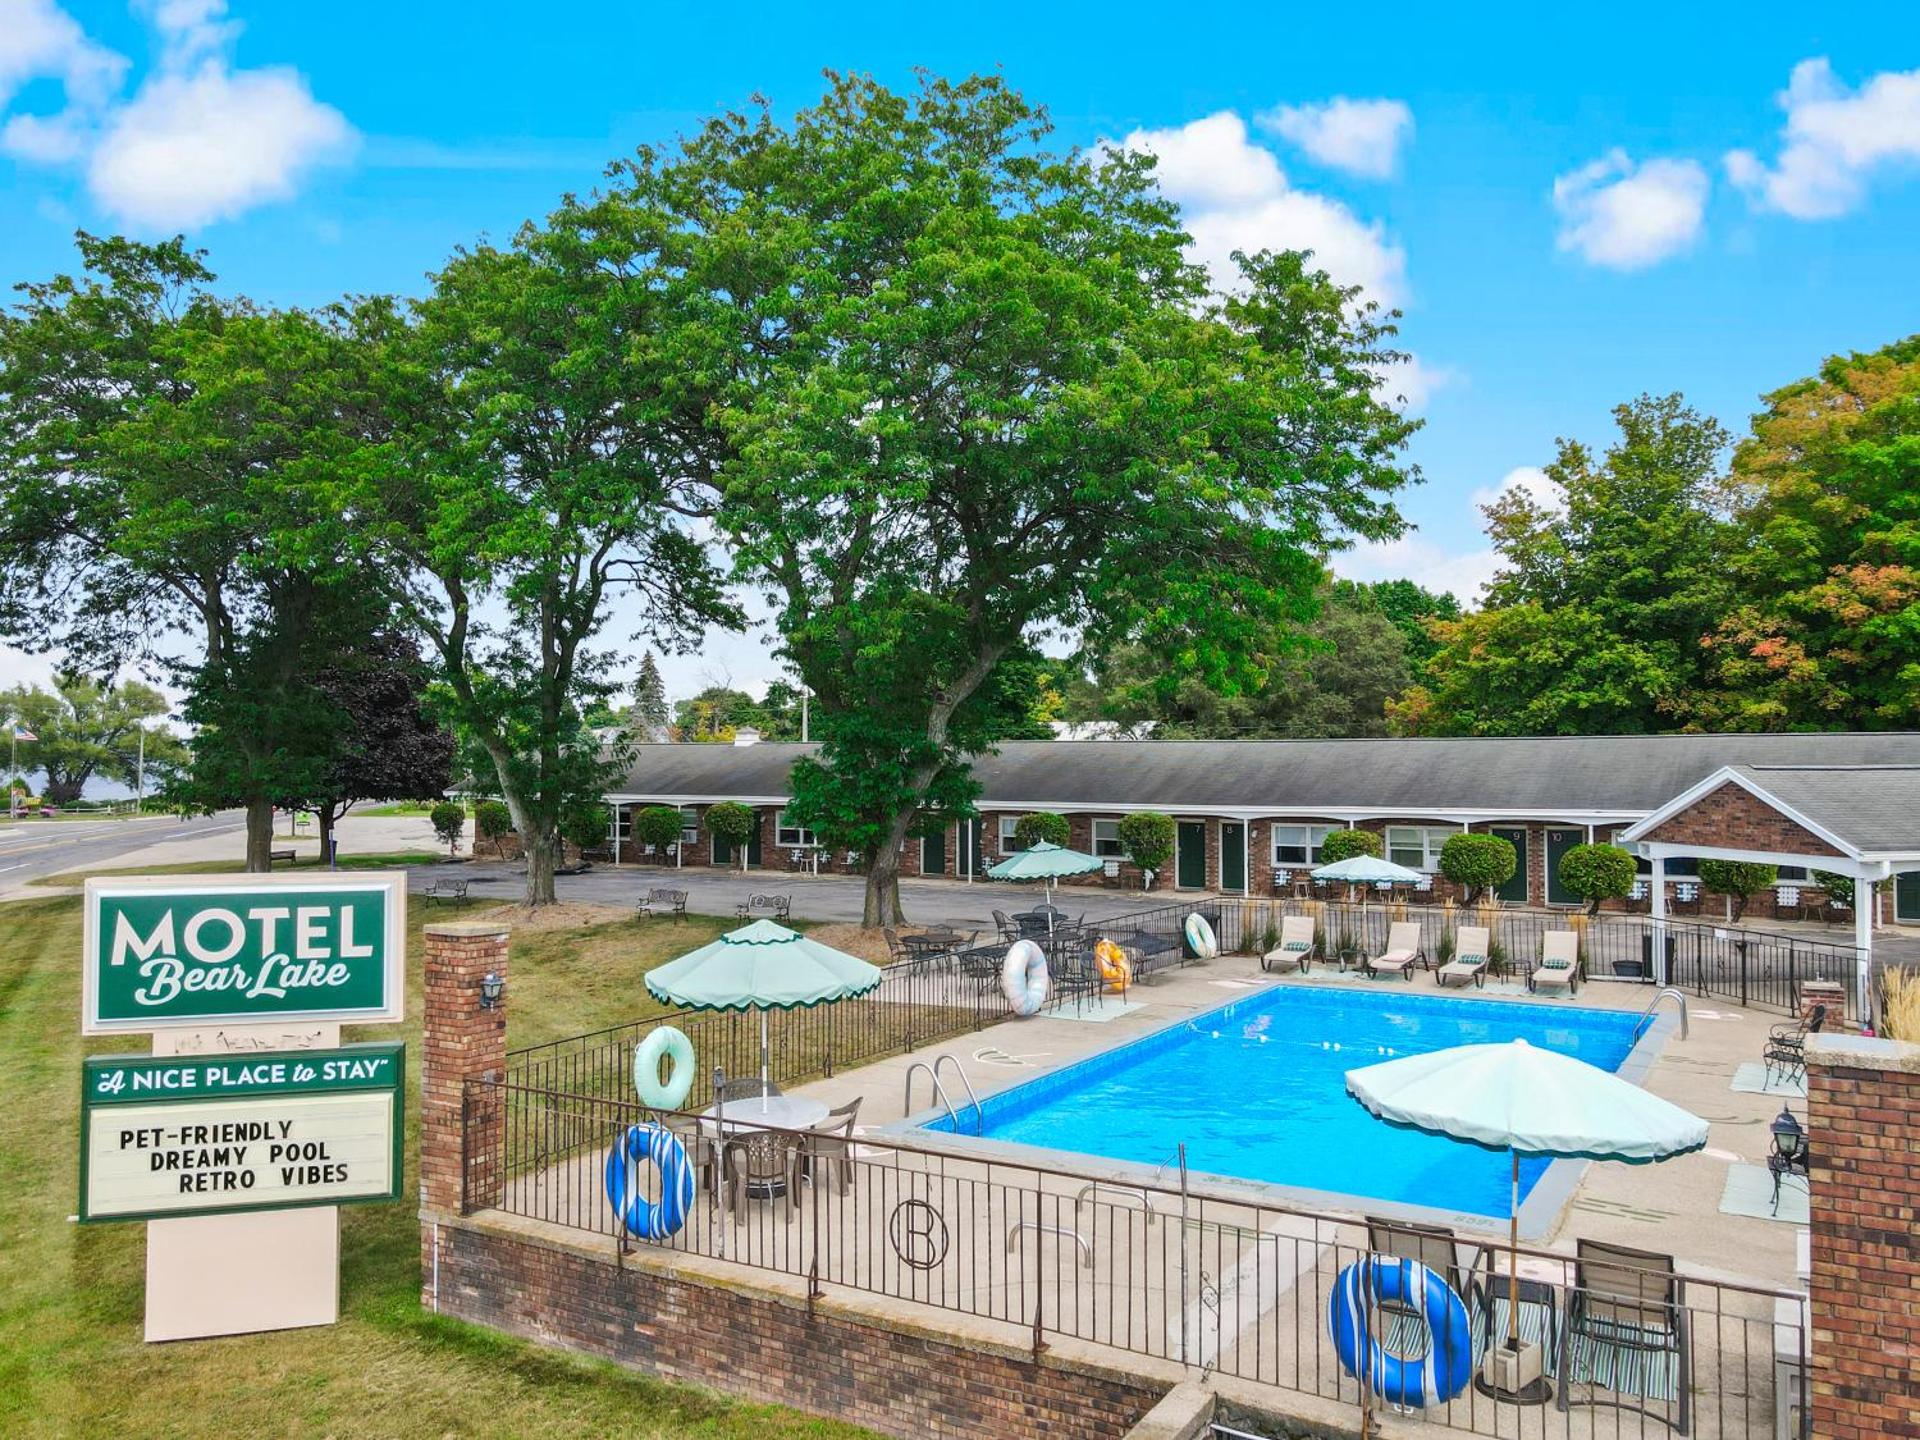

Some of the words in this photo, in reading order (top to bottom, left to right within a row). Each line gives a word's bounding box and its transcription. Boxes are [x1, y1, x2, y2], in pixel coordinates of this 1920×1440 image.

[1513, 832, 1520, 840] 9
[1552, 833, 1562, 841] 10
[111, 905, 374, 966] MOTEL
[134, 958, 253, 1006] Bear
[246, 954, 351, 999] Lake
[133, 1068, 197, 1091] NICE
[206, 1064, 285, 1087] PLACE
[293, 1064, 317, 1083] to
[120, 1120, 293, 1150] PET-FRIENDLY
[151, 1146, 248, 1171] DREAMY
[269, 1142, 331, 1164] POOL
[179, 1169, 256, 1193] RETRO
[282, 1163, 349, 1187] VIBES
[906, 1202, 936, 1265] B
